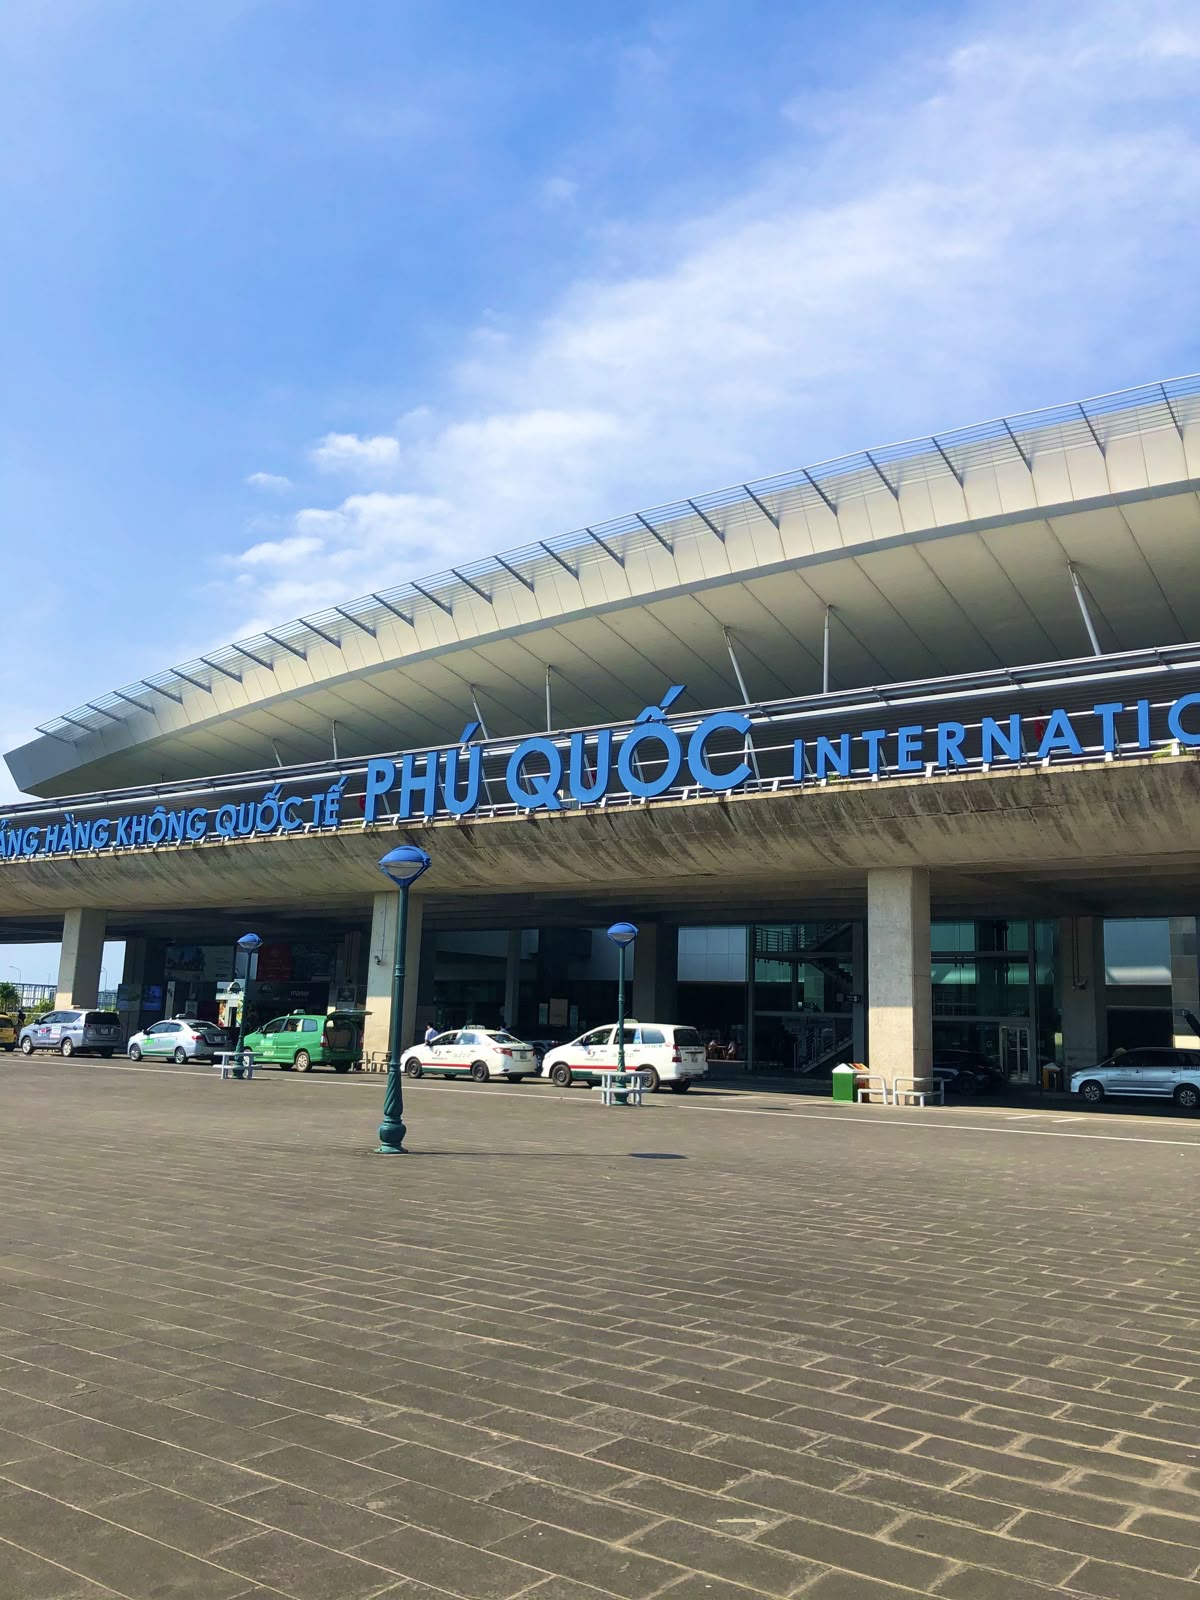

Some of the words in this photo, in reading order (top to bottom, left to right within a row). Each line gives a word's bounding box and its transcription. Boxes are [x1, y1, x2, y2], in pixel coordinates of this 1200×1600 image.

[45, 812, 111, 853] HÀNG
[115, 805, 208, 846] KHÔNG
[215, 783, 304, 837] QUỐC
[311, 775, 348, 827] TẾ
[364, 722, 482, 823] PHÚ
[506, 684, 753, 810] QUỐC
